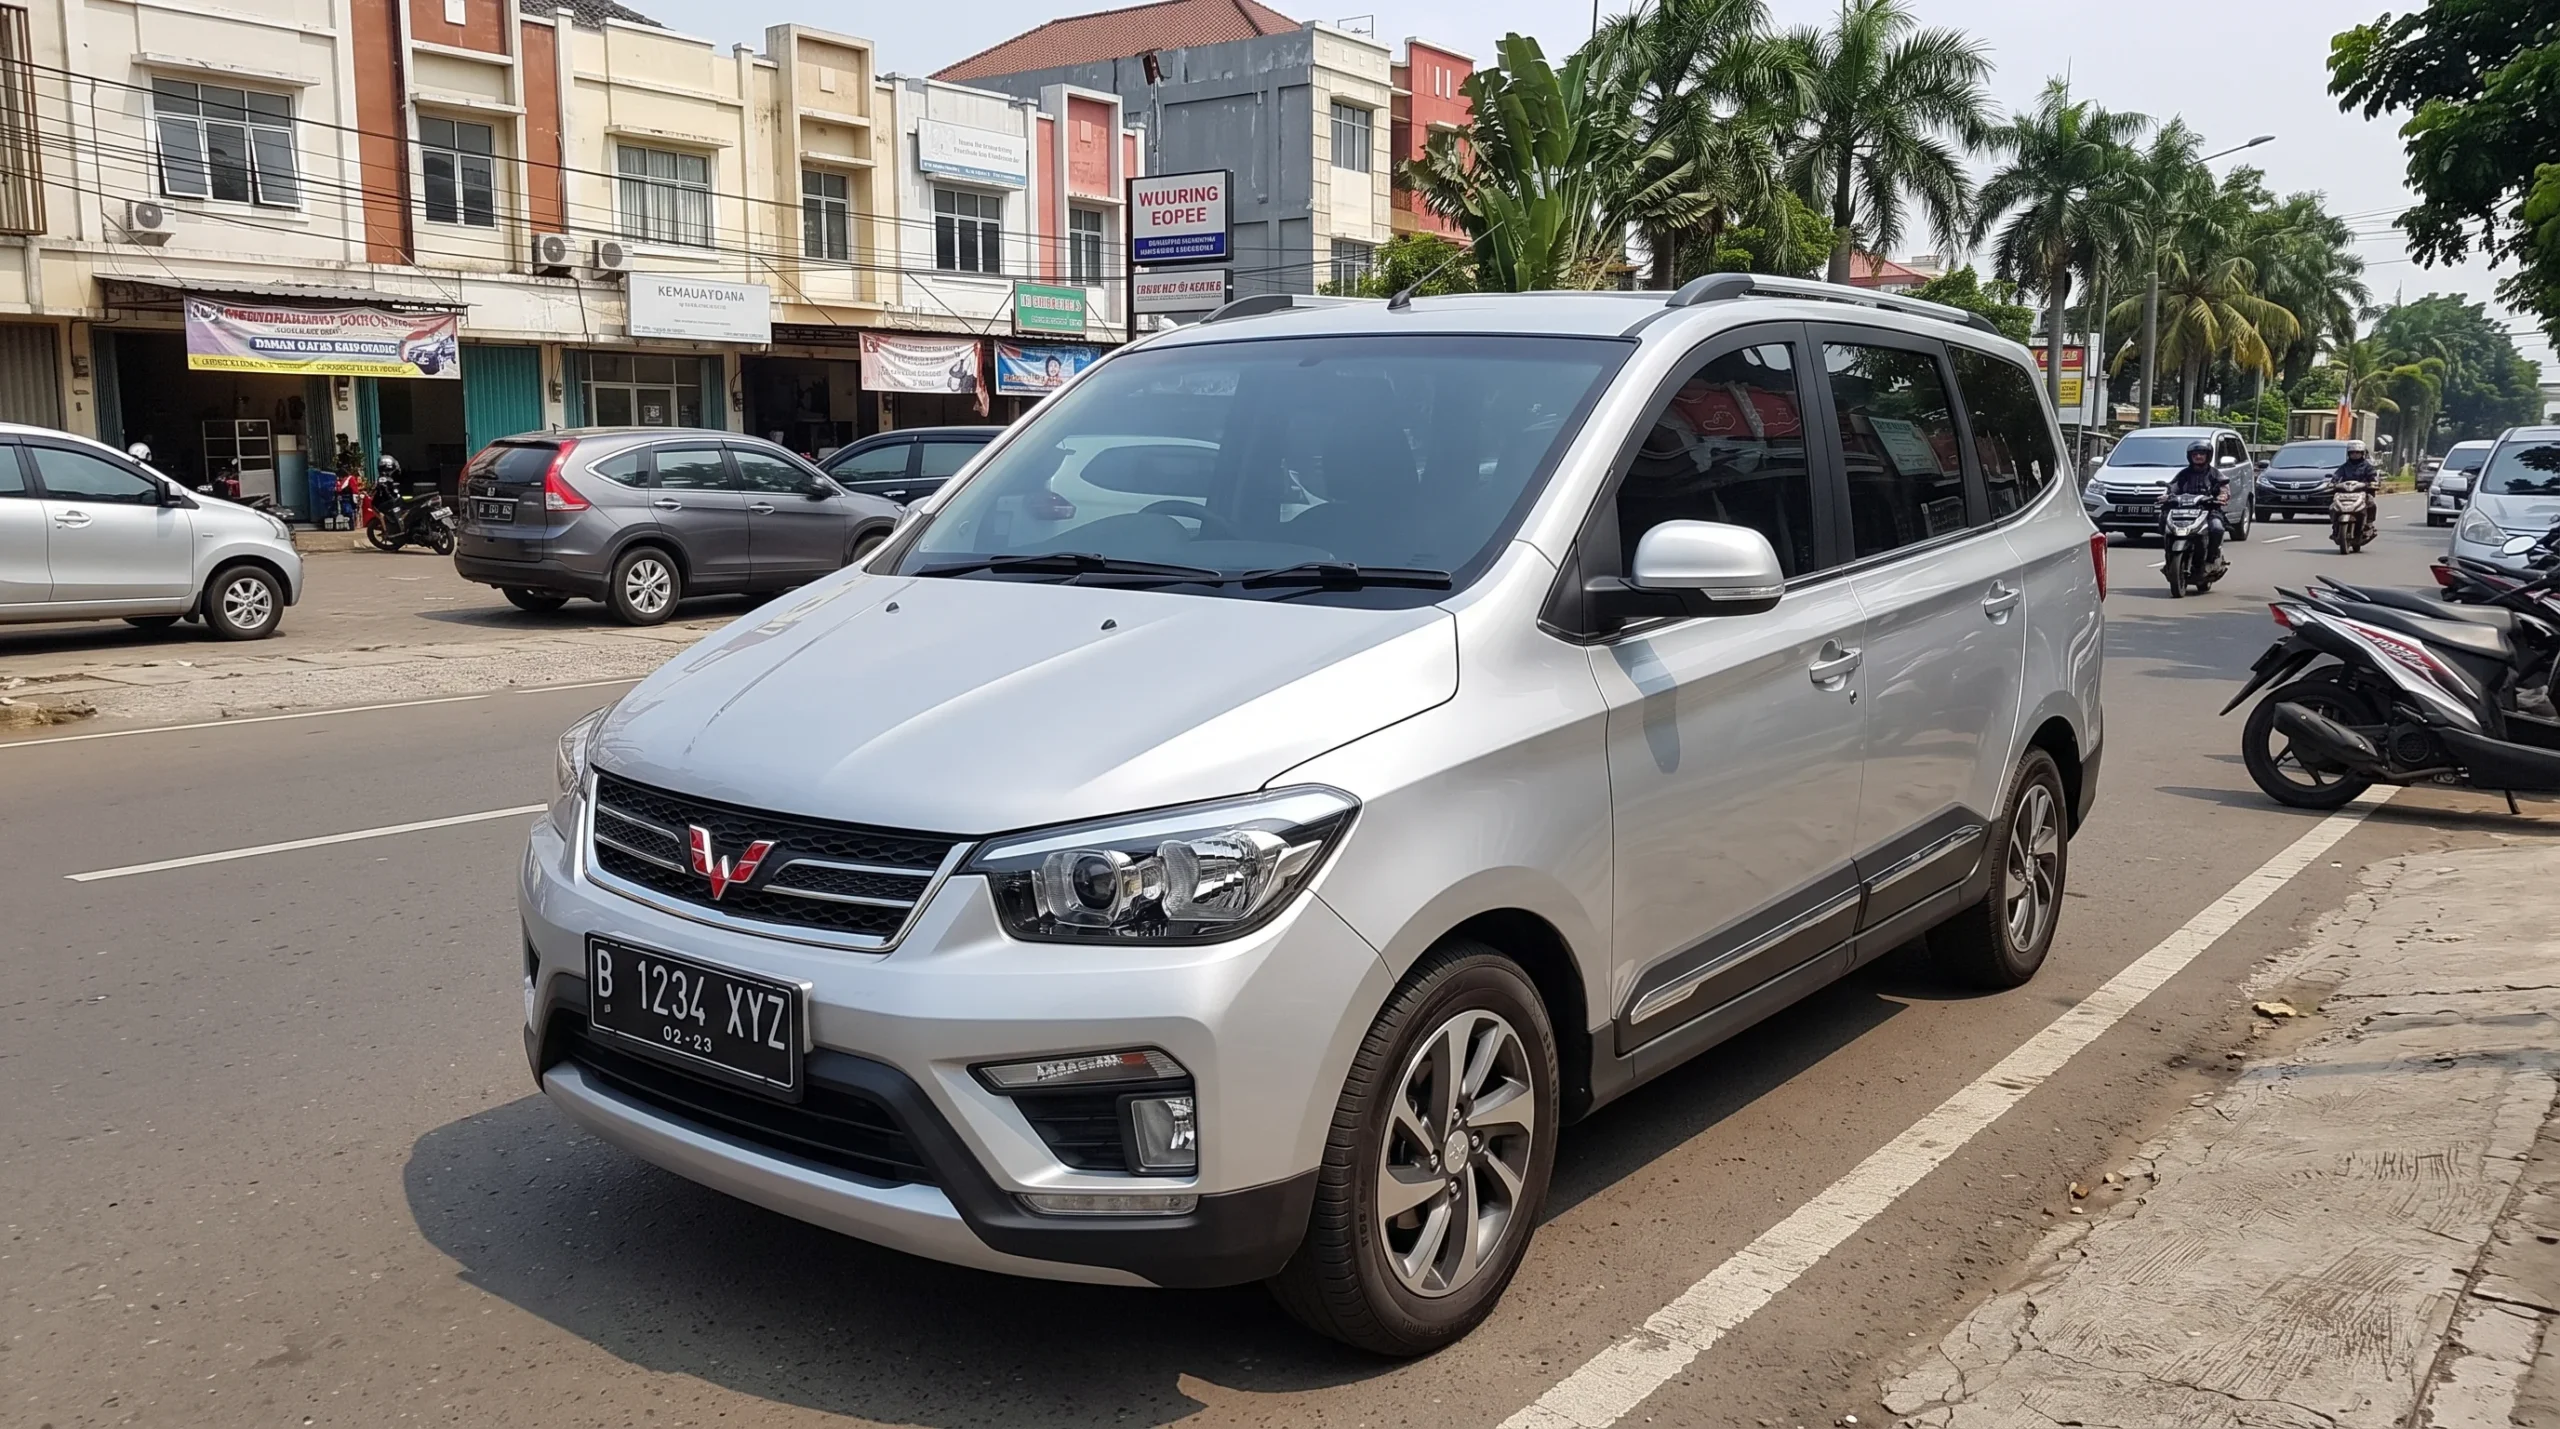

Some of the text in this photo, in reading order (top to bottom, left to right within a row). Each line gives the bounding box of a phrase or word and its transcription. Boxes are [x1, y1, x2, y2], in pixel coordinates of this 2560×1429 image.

[1139, 186, 1219, 208] WUURING
[1151, 207, 1207, 226] EOPEE
[596, 948, 785, 1051] B 1234 XYZ
